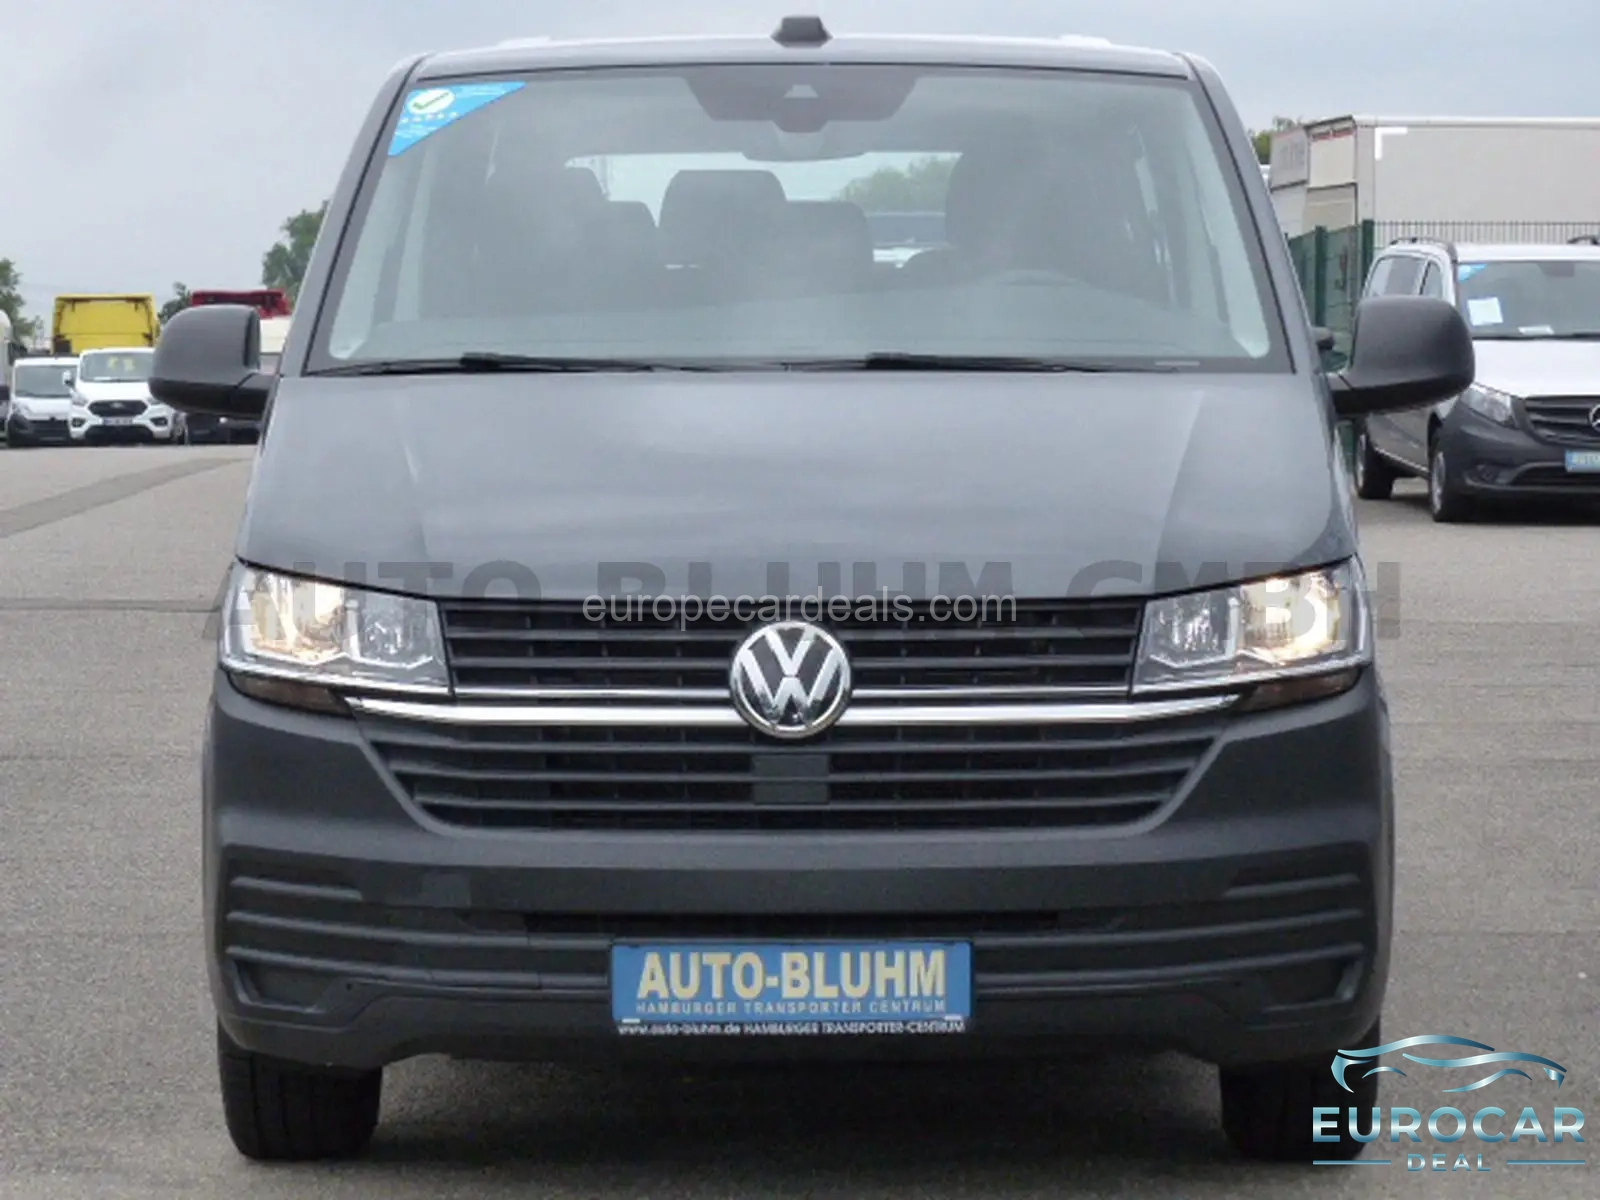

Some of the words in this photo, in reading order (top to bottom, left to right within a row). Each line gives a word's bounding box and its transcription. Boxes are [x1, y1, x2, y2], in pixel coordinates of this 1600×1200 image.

[637, 951, 946, 998] AUTO-BLUHM
[636, 1002, 736, 1014] HAMBURGER
[744, 1001, 862, 1013] TRANSPORTER
[869, 1000, 946, 1013] CENTRUM
